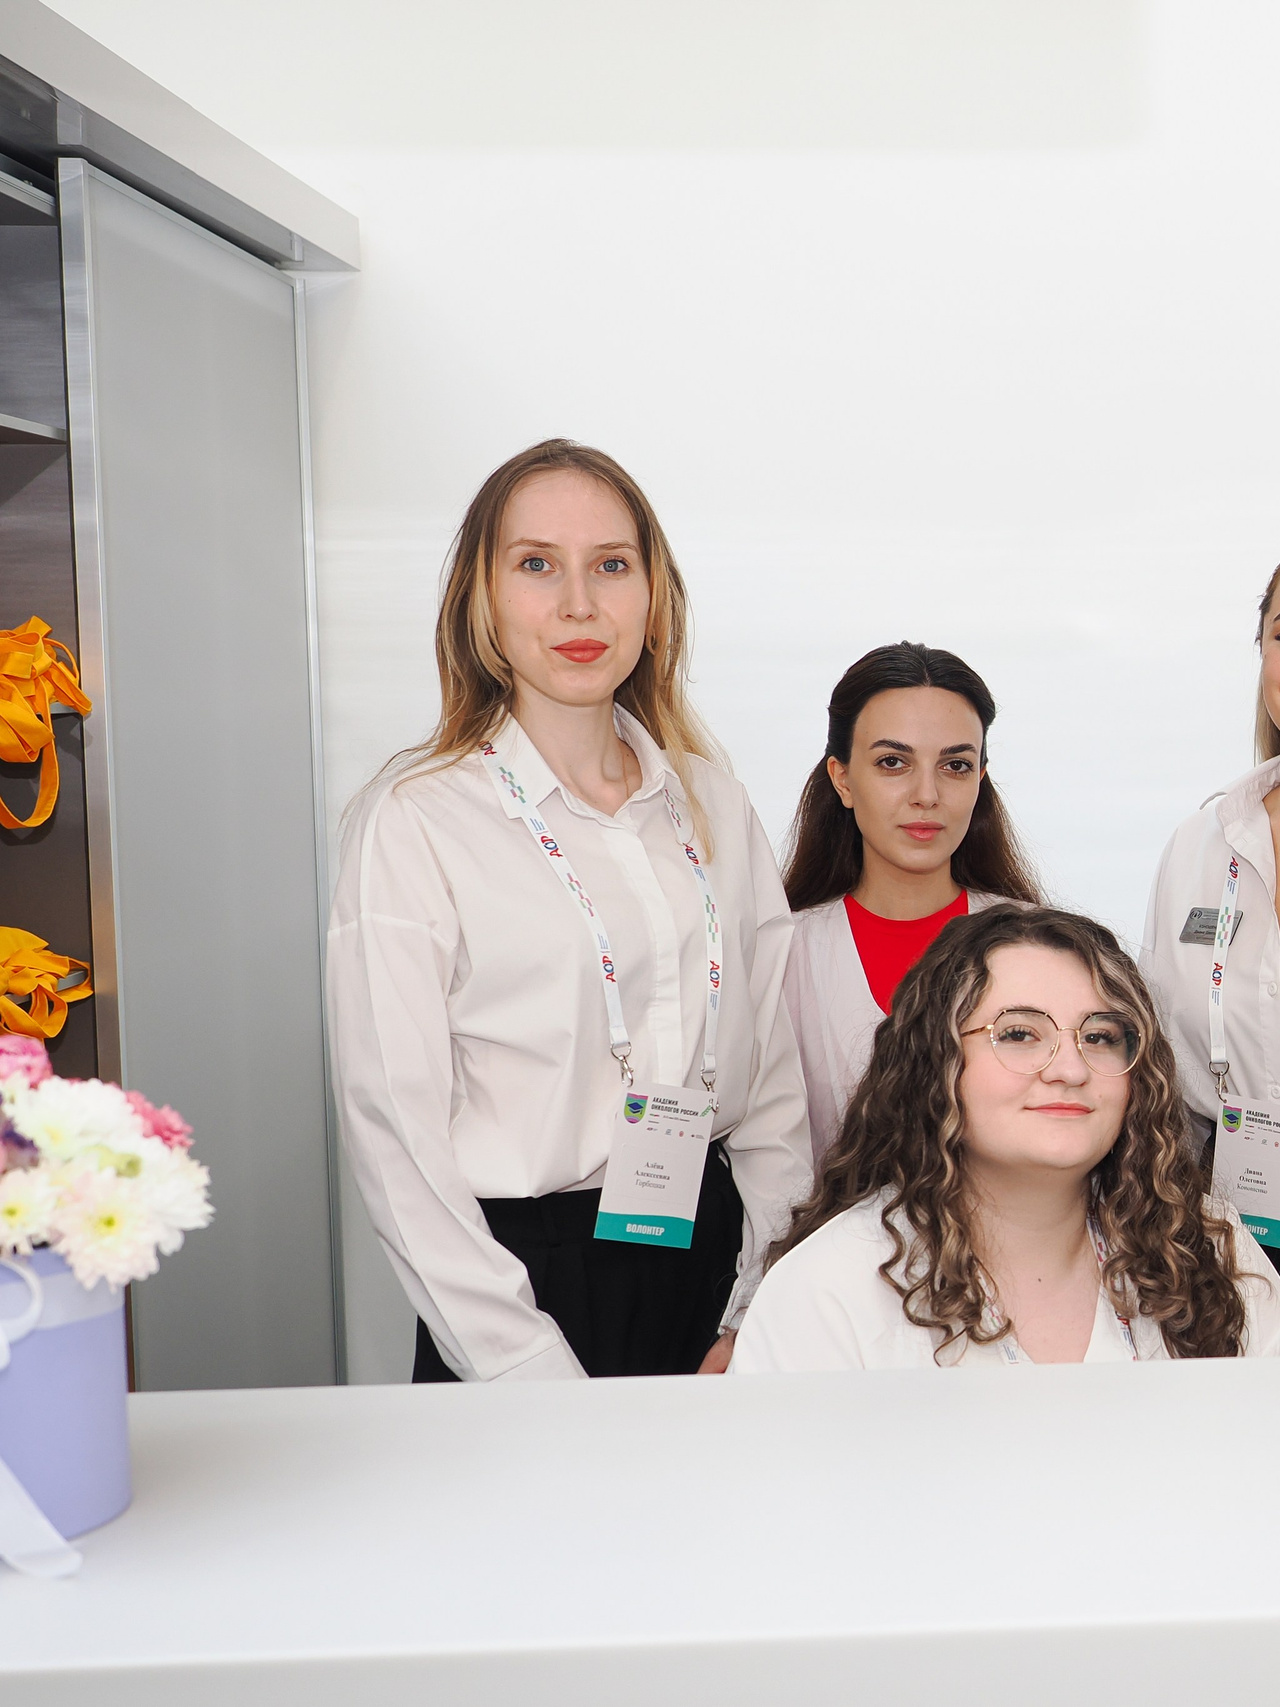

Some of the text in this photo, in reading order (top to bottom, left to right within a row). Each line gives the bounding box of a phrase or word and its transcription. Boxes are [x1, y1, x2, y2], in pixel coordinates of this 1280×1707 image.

[652, 1096, 679, 1106] АКАДЕМИЯ
[651, 1103, 699, 1117] ОНКОЛОГОВ РОССИИ
[1246, 1109, 1270, 1119] АКАДЕМИЯ
[1245, 1116, 1272, 1127] ОНКОЛОГОВ
[626, 1223, 665, 1236] ВОЛОНТЕР
